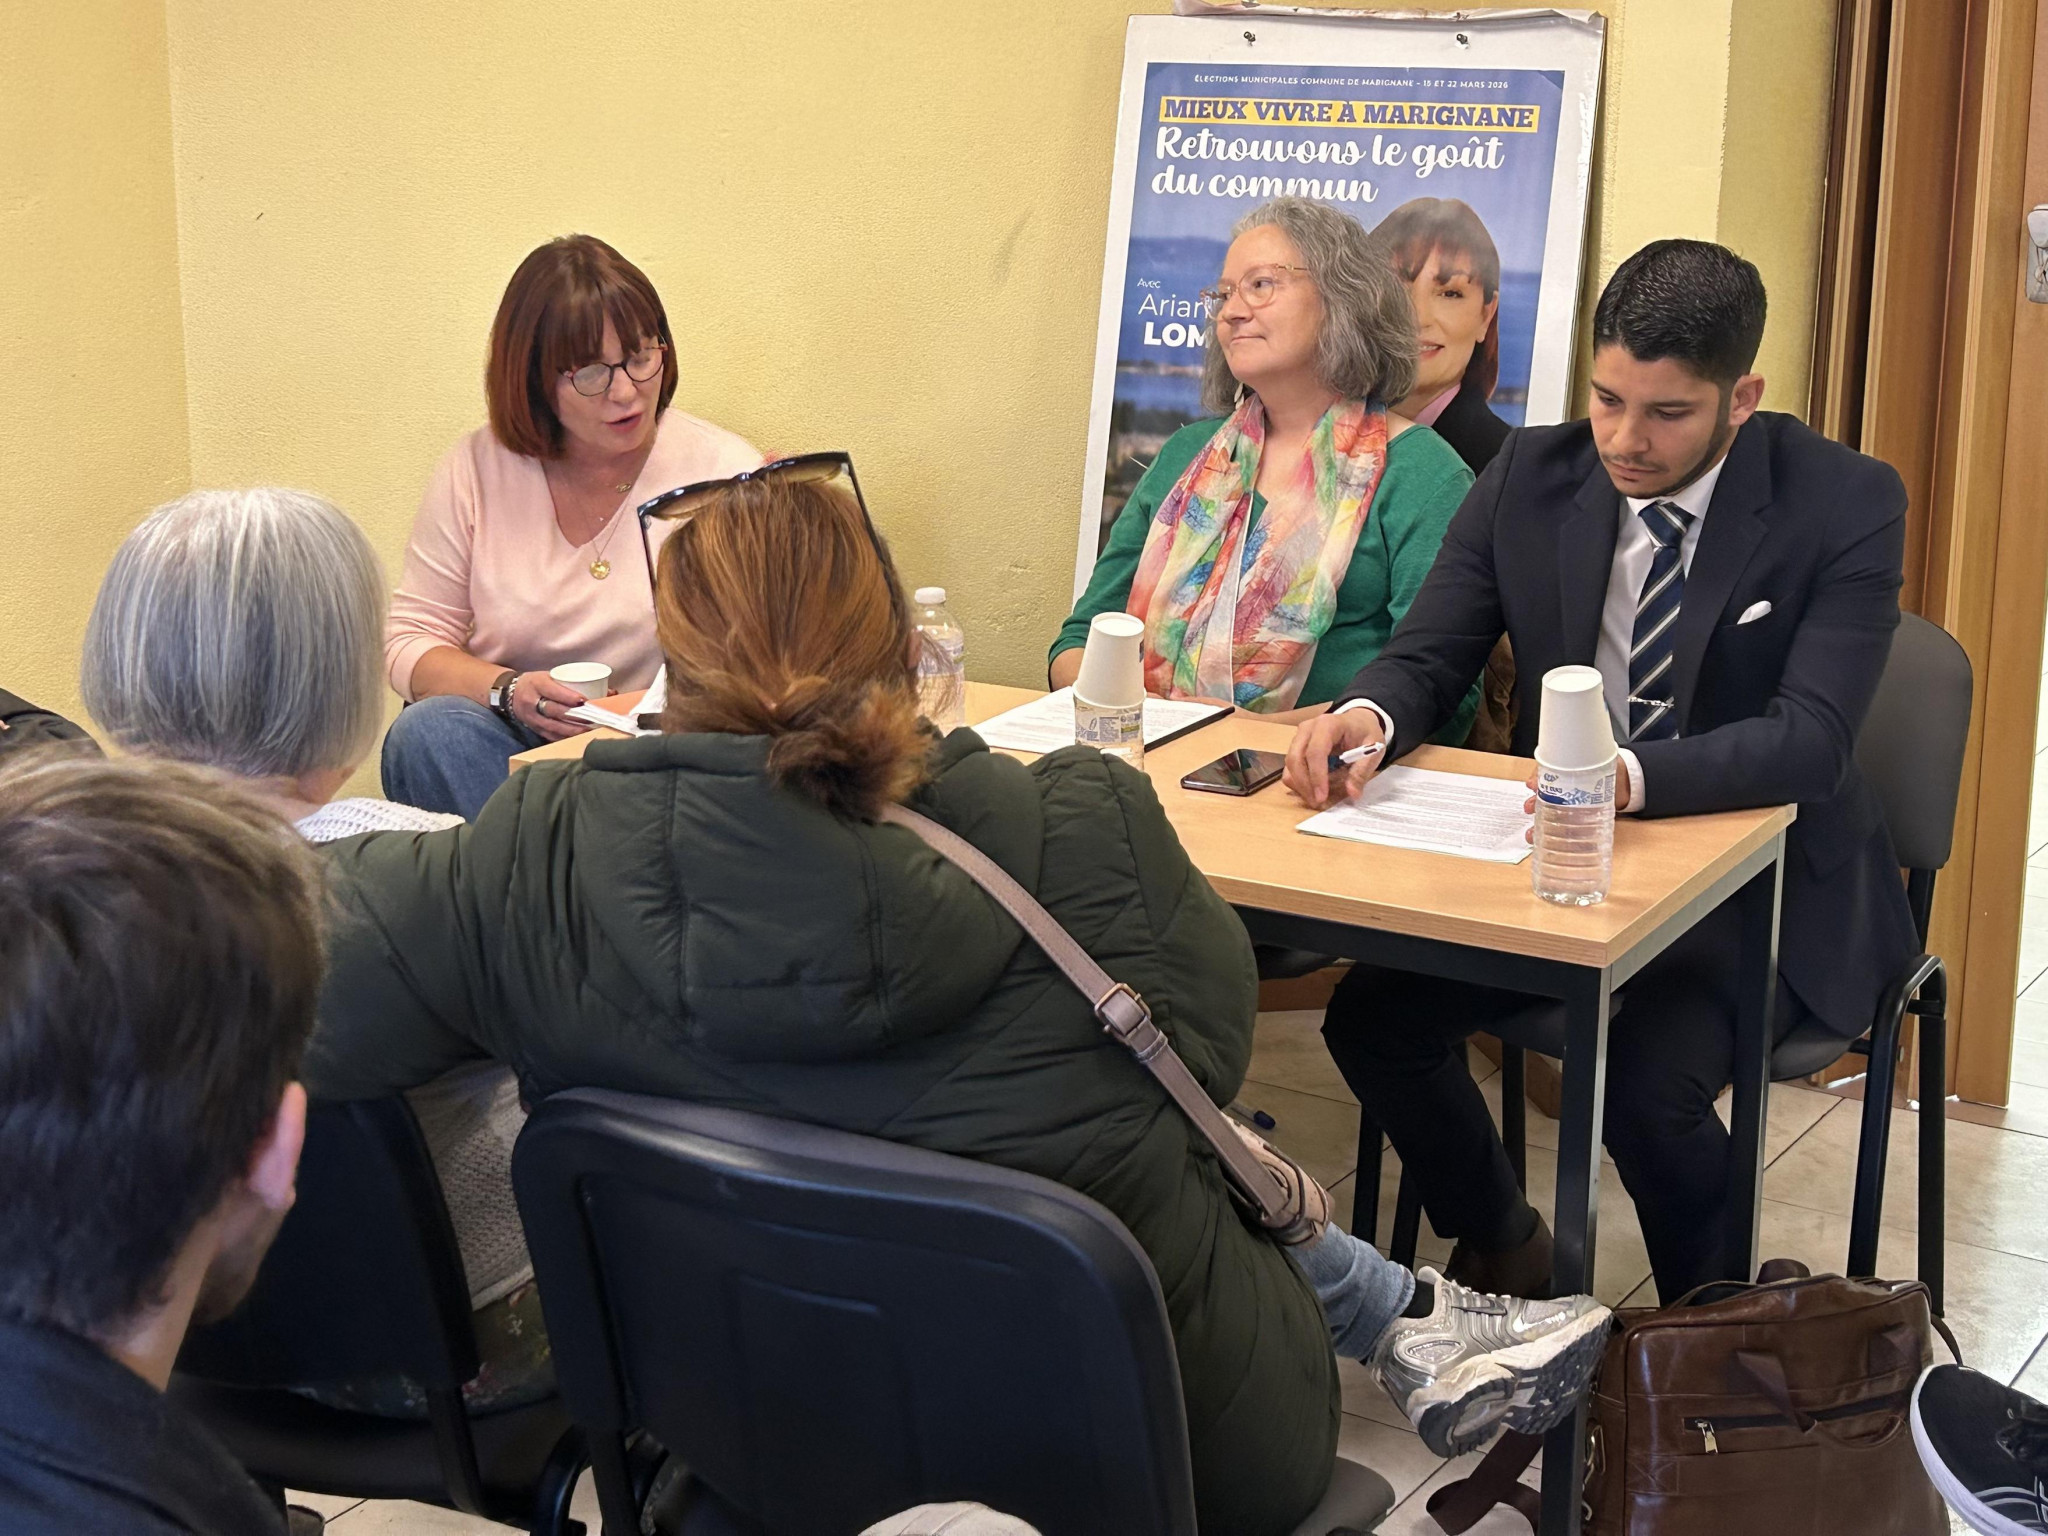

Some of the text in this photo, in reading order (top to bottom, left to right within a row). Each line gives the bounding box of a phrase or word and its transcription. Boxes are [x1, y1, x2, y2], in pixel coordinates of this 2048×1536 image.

[1241, 75, 1299, 85] MUNICIPALES
[1300, 77, 1345, 86] COMMUNE
[1362, 79, 1414, 87] MARIGNANE
[1487, 81, 1509, 89] 2026
[1164, 99, 1534, 127] MIEUX VIVRE À MARIGNANE
[1156, 126, 1505, 179] Retrouvons le goût
[1151, 164, 1379, 203] du commun
[1137, 278, 1161, 288] Avec
[1138, 293, 1209, 319] Arian
[1143, 321, 1209, 349] LOM
